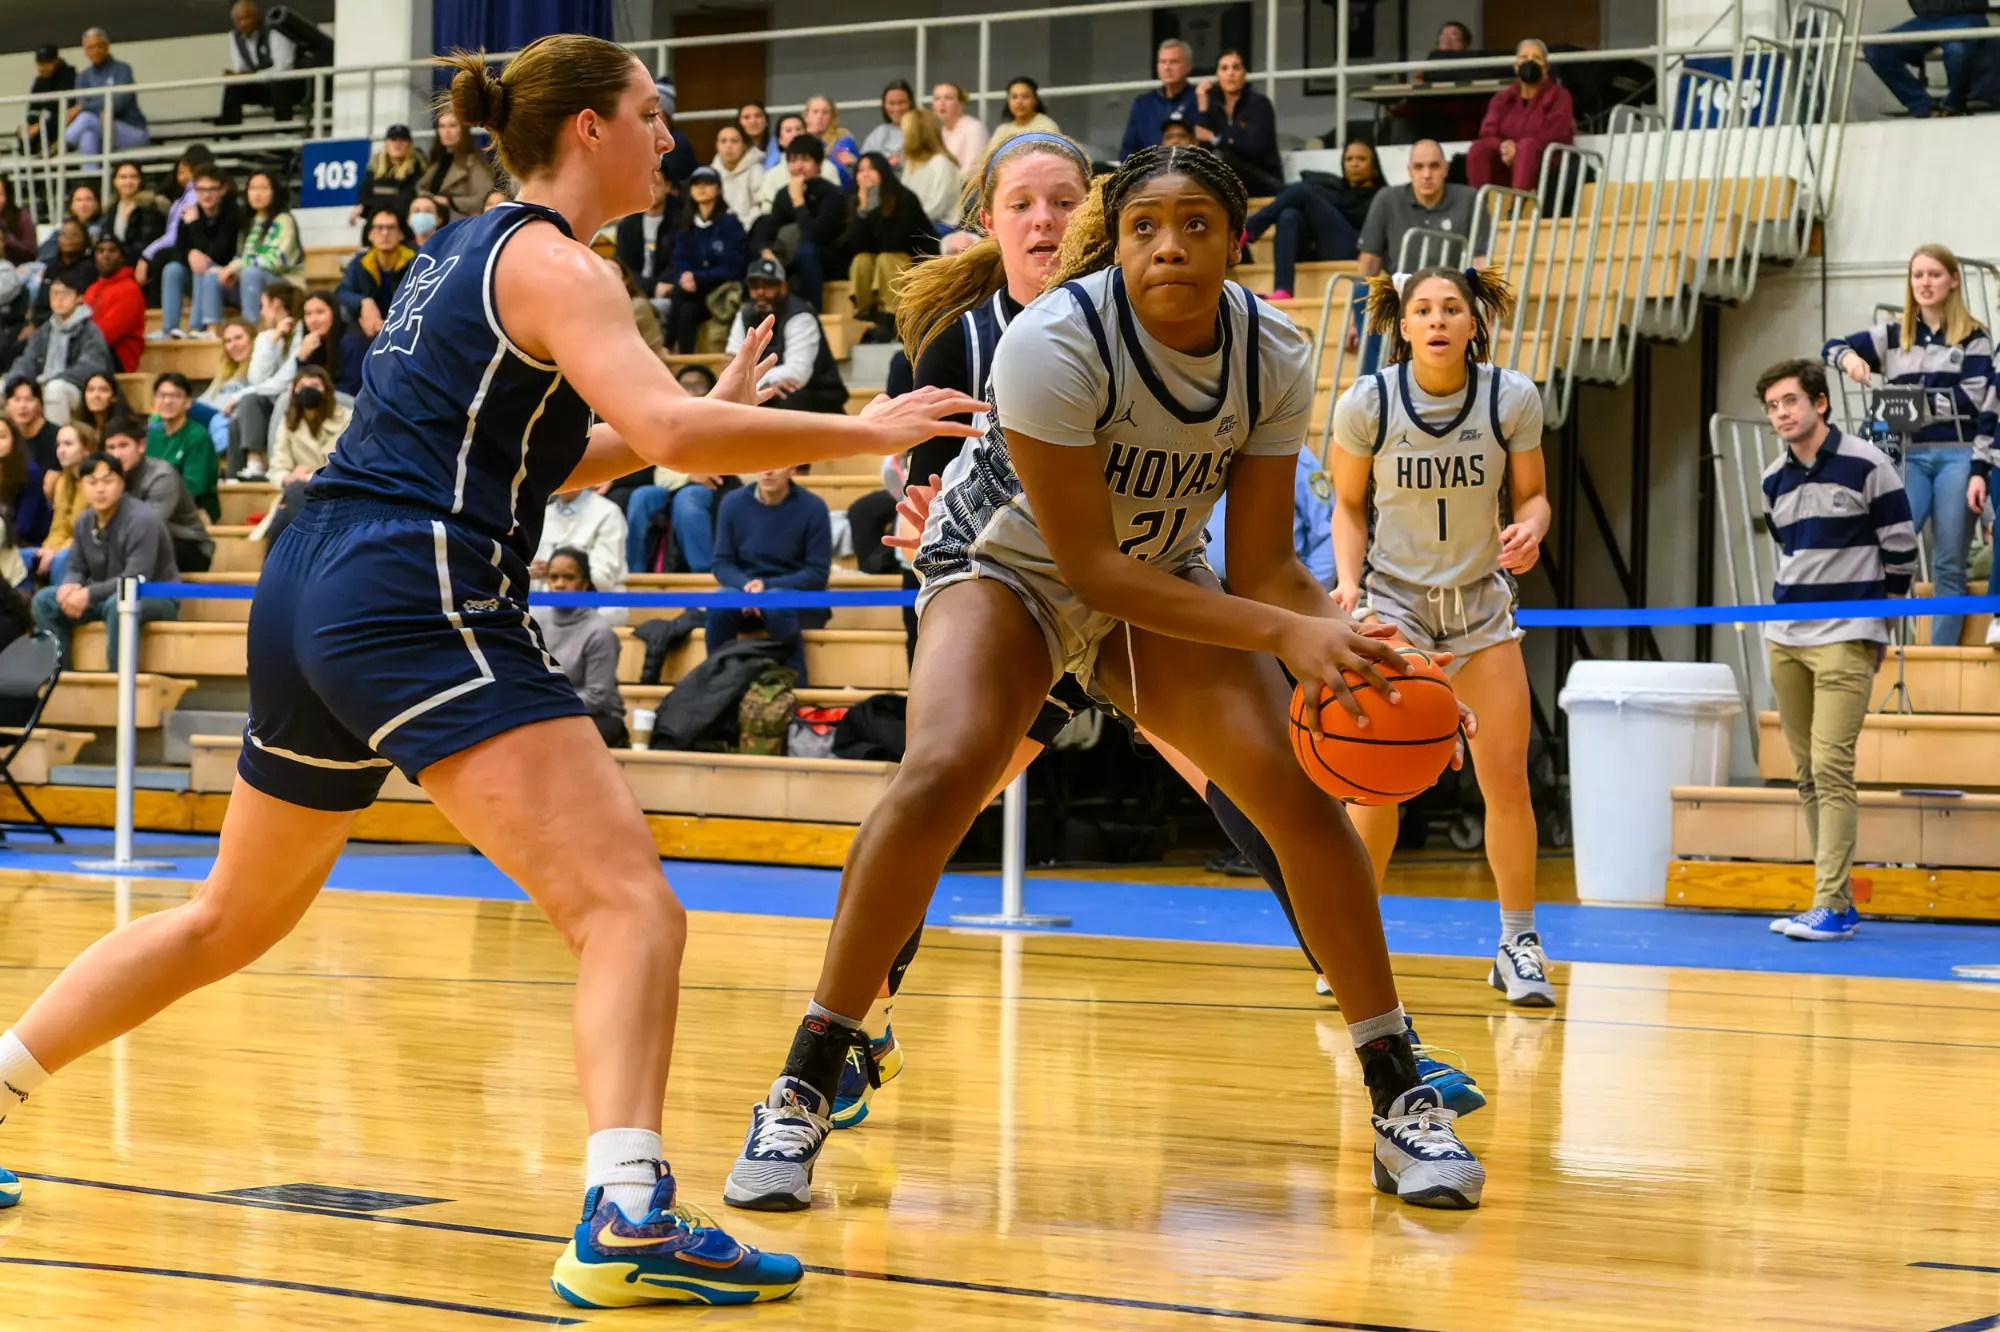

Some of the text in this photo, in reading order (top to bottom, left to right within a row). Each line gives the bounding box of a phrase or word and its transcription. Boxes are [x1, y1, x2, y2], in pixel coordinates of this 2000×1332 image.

[314, 160, 358, 190] 103
[1104, 441, 1234, 500] HOYAS
[1396, 454, 1485, 490] HOYAS
[1119, 506, 1188, 562] 21
[1437, 498, 1447, 541] 1
